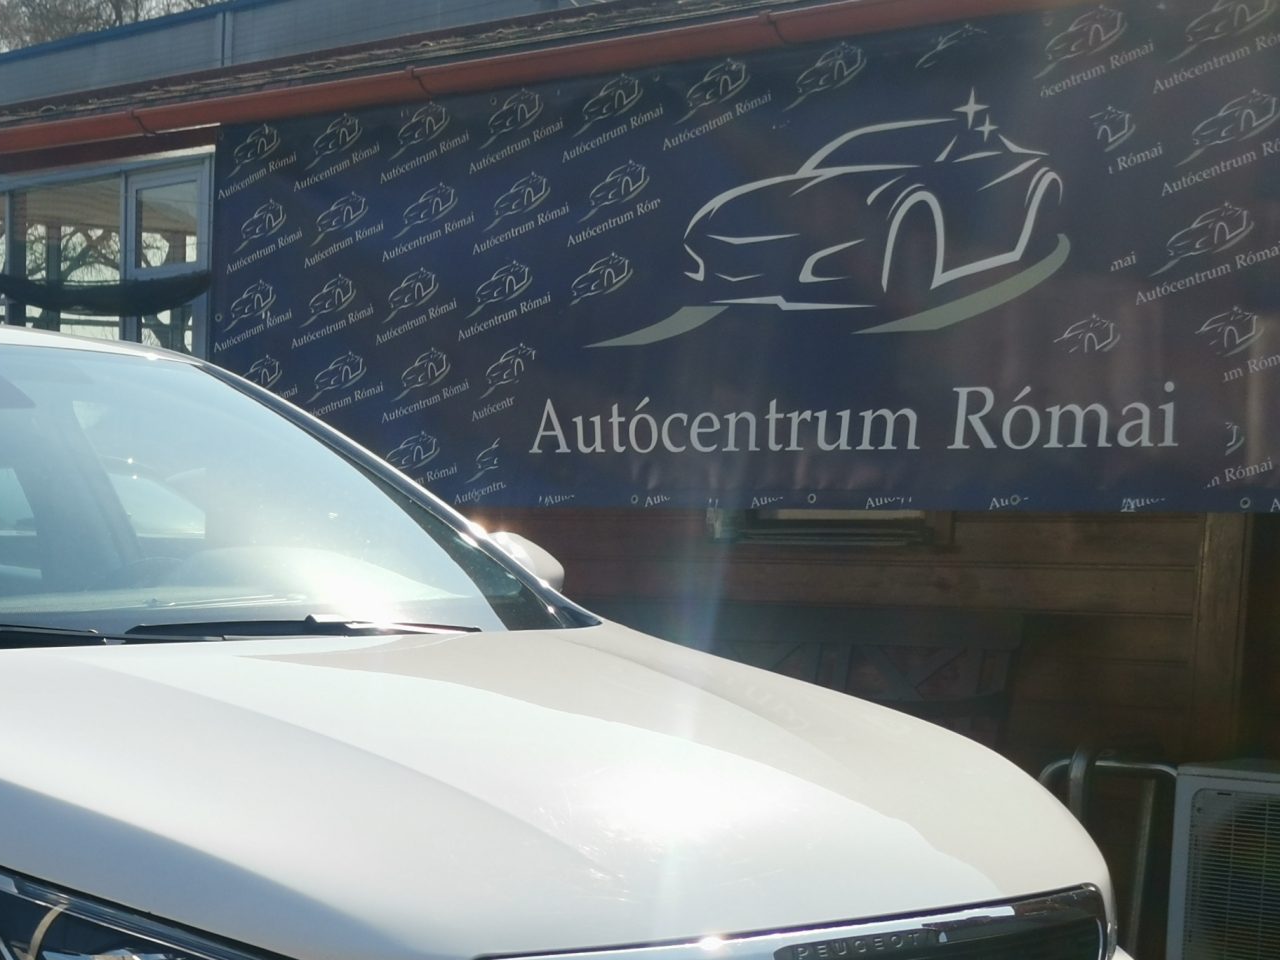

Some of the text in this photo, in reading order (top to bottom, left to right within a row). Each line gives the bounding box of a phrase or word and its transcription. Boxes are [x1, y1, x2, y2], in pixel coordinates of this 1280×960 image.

[1040, 38, 1154, 98] ócentrum Római
[1153, 46, 1250, 94] Autócentrum
[562, 104, 664, 163] Autócentrum Római
[663, 90, 772, 151] Autócentrum Római
[293, 142, 381, 192] Autócentrum Római
[380, 130, 470, 184] Autócentrum Római
[469, 117, 564, 175] Autócentrum Római
[1116, 142, 1164, 171] Római
[217, 152, 298, 200] Autócentrum Római
[1161, 151, 1257, 197] Autócentrum
[303, 222, 385, 269] Autócentrum Római
[382, 212, 475, 263] Autócentrum Római
[472, 202, 570, 255] Autócentrum Római
[567, 197, 662, 248] Autócentrum Róm
[226, 227, 303, 275] Autócentrum Római
[1110, 251, 1137, 272] mai
[1135, 263, 1232, 306] Autócentrum
[214, 322, 265, 353] Autócentrum
[291, 306, 374, 350] Autócentrum Római
[376, 298, 458, 346] Autócentrum Római
[458, 291, 552, 342] Autócentrum Római
[1247, 354, 1280, 374] Róm
[354, 381, 384, 402] Római
[381, 378, 470, 424] Autócentrum Római
[471, 396, 516, 422] Autócentr
[528, 381, 1179, 454] Autócentrum Római
[426, 463, 458, 484] Római
[1224, 456, 1273, 482] Római
[796, 933, 920, 960] PEUGEOT
